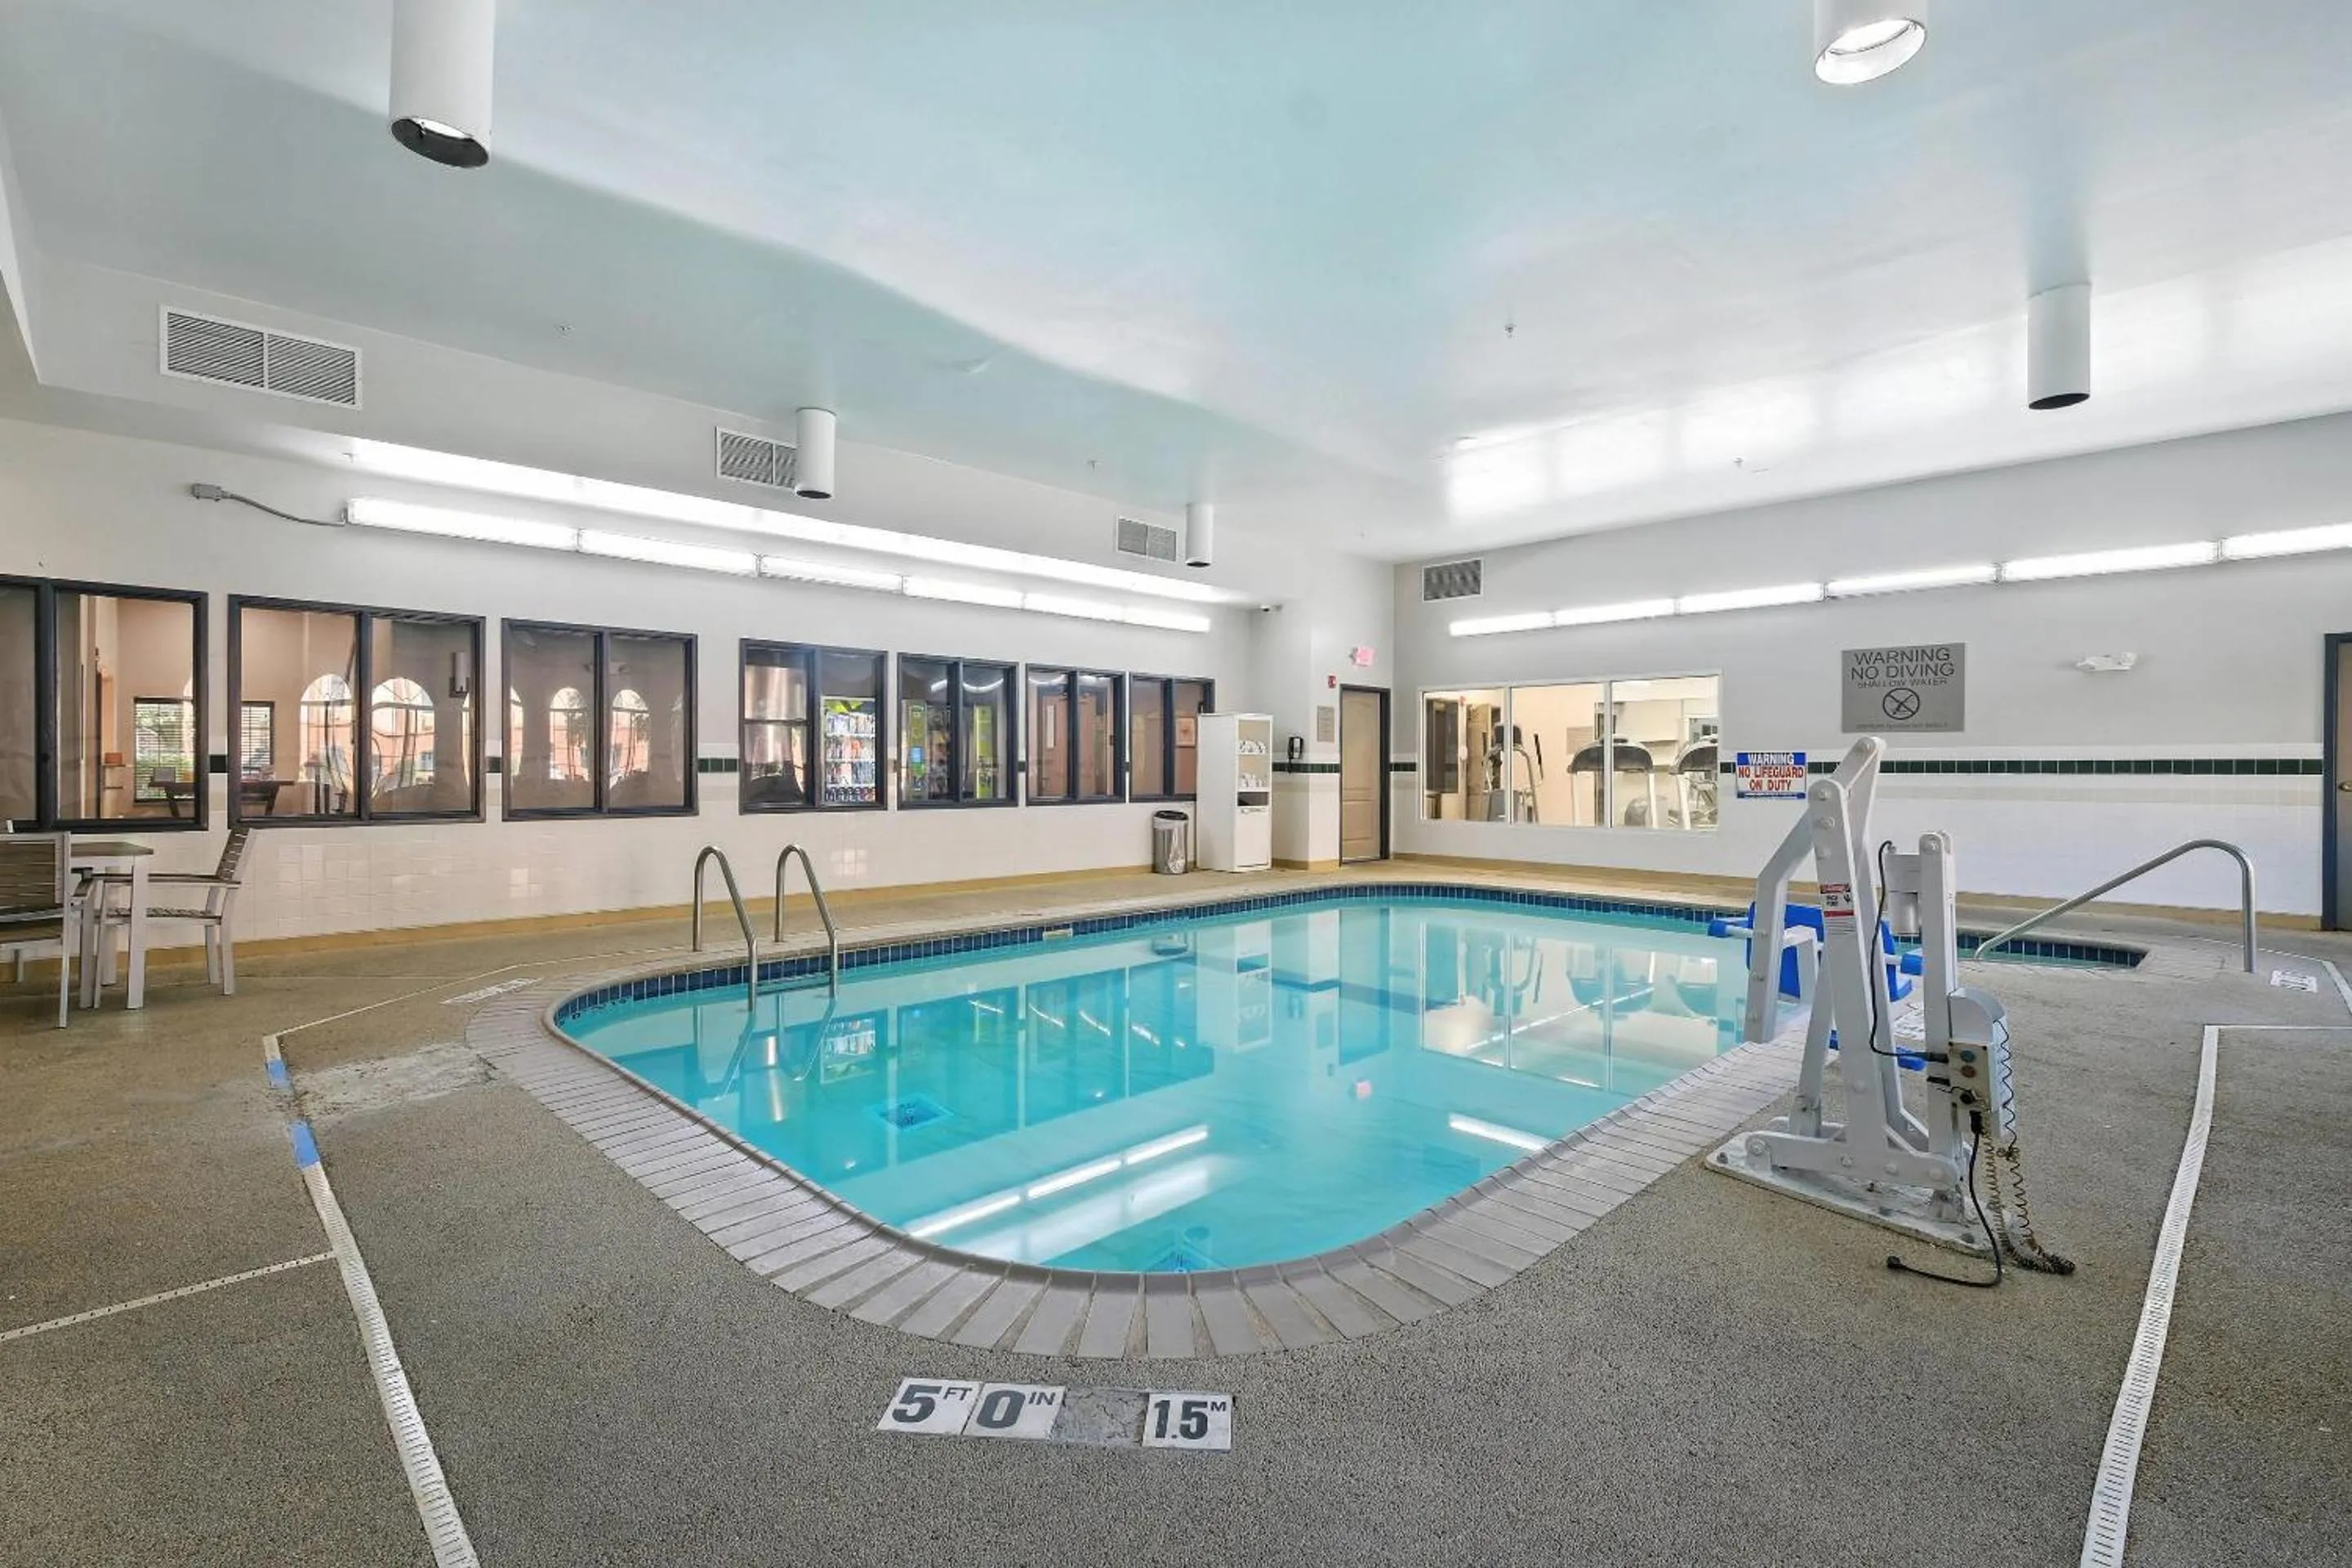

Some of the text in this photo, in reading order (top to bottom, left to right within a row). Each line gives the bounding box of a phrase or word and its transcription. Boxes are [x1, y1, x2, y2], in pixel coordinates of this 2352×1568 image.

[1854, 647, 1950, 666] WARNING
[1851, 662, 1955, 680] NO DIVING
[1857, 677, 1947, 688] SHALLOW WATER
[1748, 753, 1794, 765] WARNING
[1738, 766, 1804, 778] NO LIFEGUARD
[1749, 779, 1791, 791] ON DUTY
[892, 1384, 1056, 1428] 5 FT 0 IN
[1154, 1401, 1227, 1440] 1.5 M
